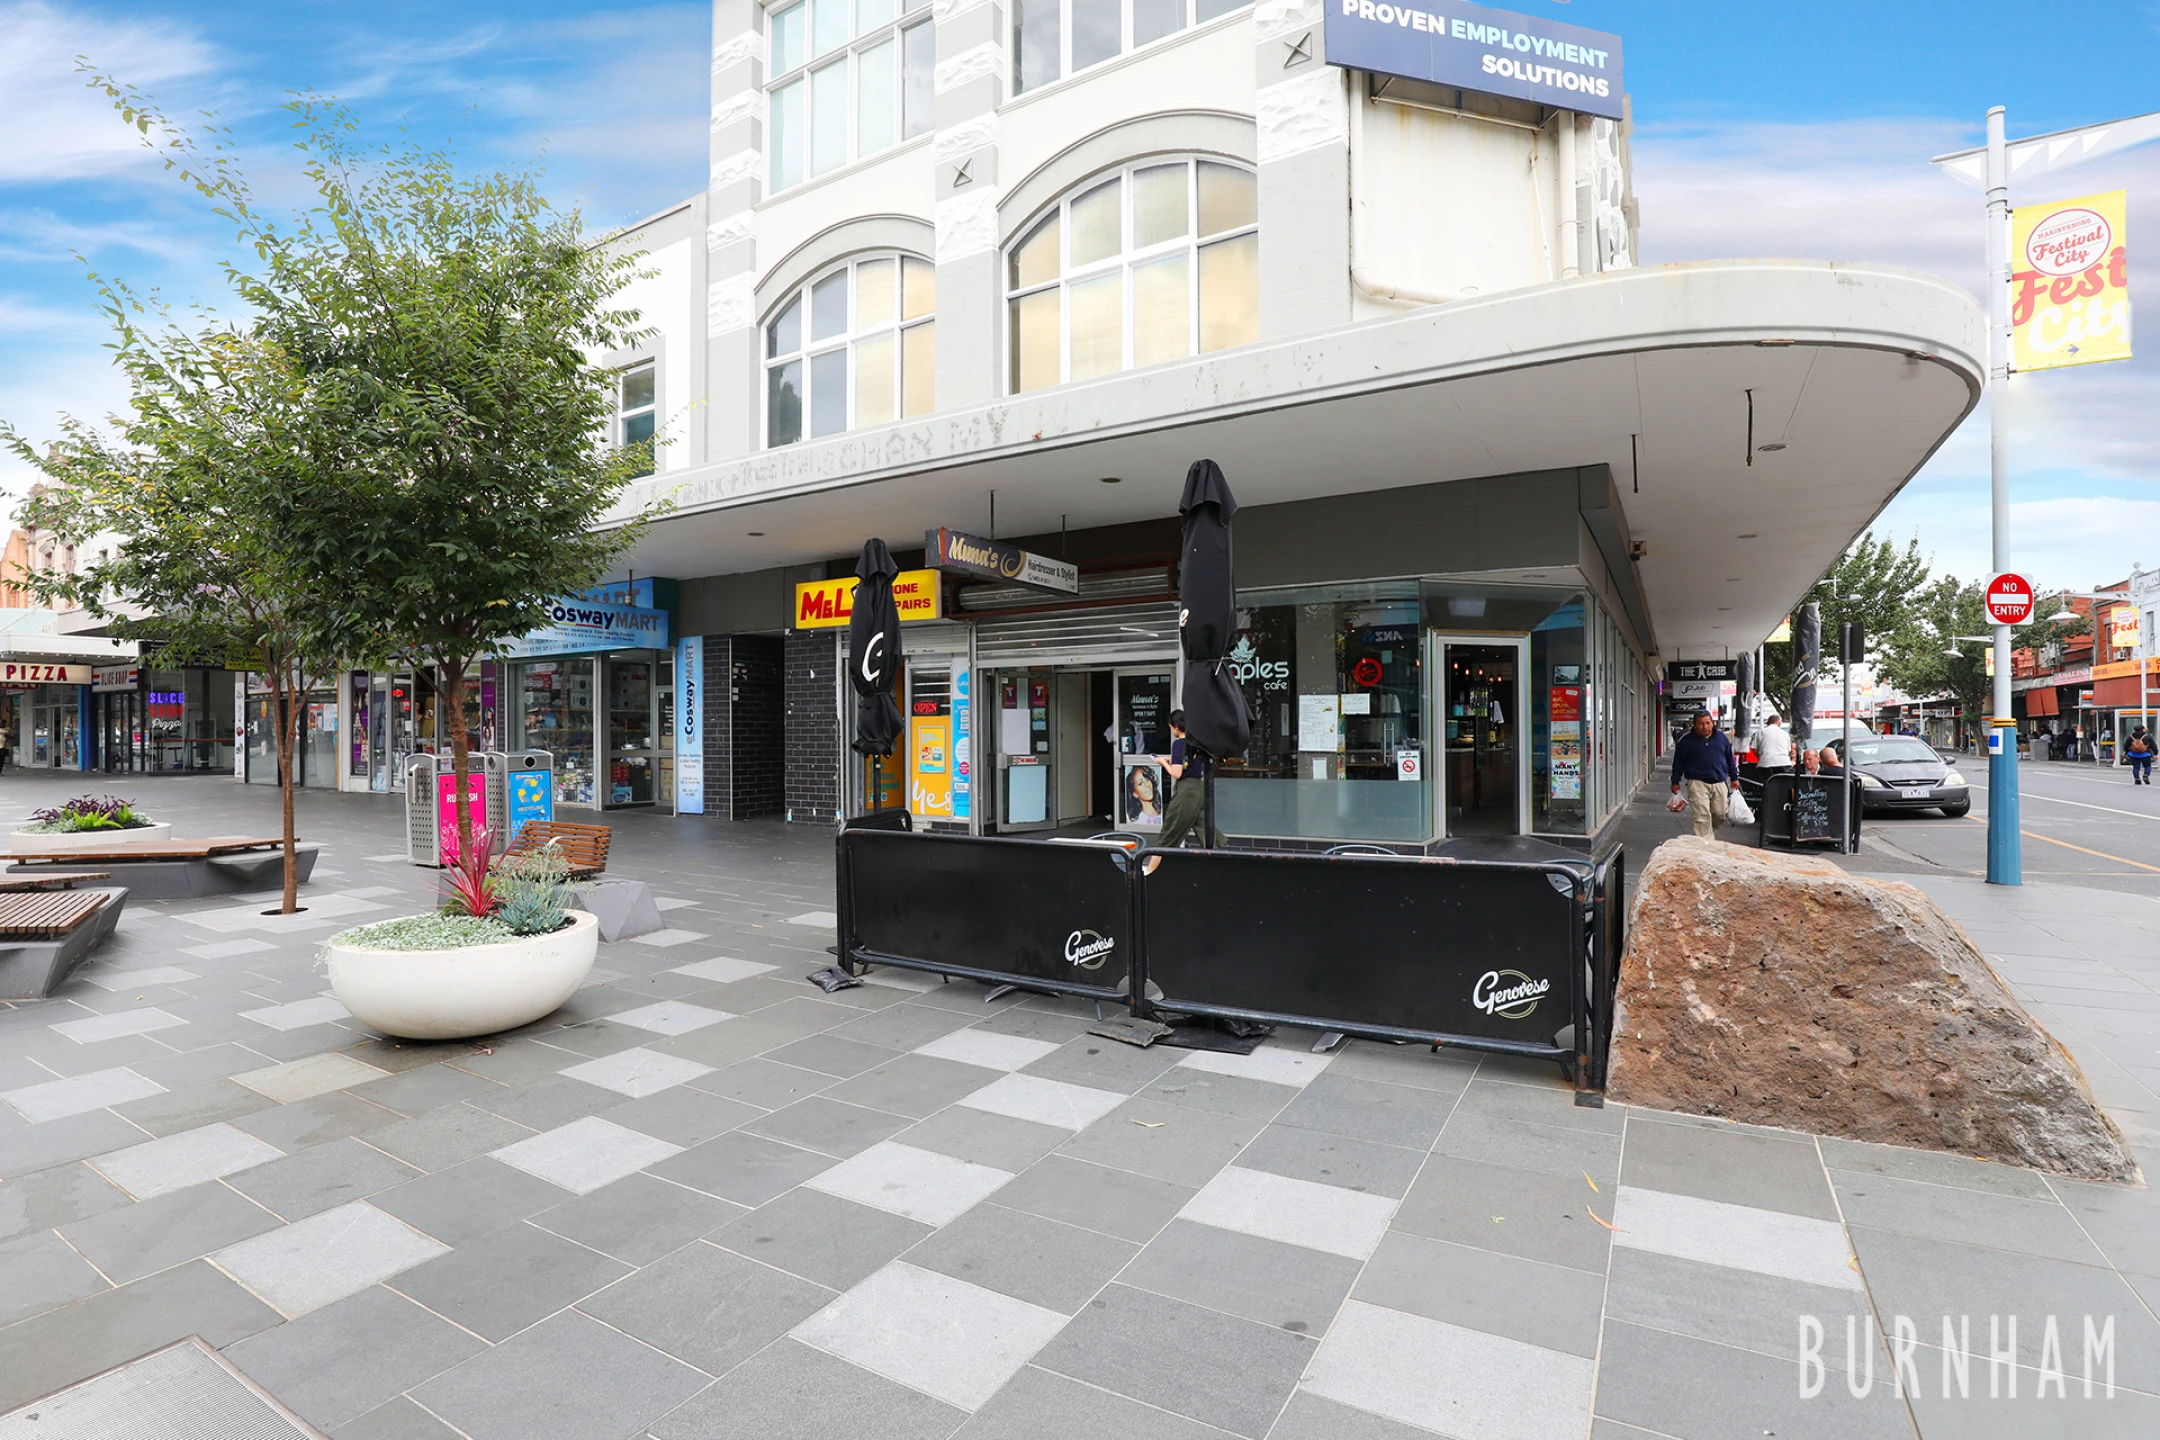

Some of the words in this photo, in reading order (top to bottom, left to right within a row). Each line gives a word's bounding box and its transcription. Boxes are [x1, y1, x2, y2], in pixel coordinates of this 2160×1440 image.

[1343, 0, 1445, 35] PROVEN
[1451, 18, 1608, 69] EMPLOYMENT
[1482, 54, 1609, 97] SOLUTIONS
[2037, 217, 2092, 239] MARIBYRNONG
[2032, 225, 2104, 261] Festival
[2054, 250, 2090, 267] City
[2012, 246, 2127, 326] Fest
[891, 583, 918, 594] ONE
[2003, 582, 2017, 593] NO
[895, 598, 931, 611] PAIRS
[1994, 605, 2026, 616] ENTRY
[2111, 619, 2139, 635] Fest
[6, 664, 68, 682] PIZZA
[1228, 656, 1289, 685] aples
[1680, 666, 1696, 676] THE
[1706, 666, 1726, 676] CRIB
[100, 671, 114, 686] SLICE
[1263, 679, 1288, 691] cafe
[149, 692, 185, 704] SLICE
[913, 702, 938, 713] OPEN
[152, 718, 182, 730] Pizza
[446, 792, 478, 803] RUSH
[1065, 930, 1115, 966] Genovese
[1473, 970, 1550, 1015] Genovese
